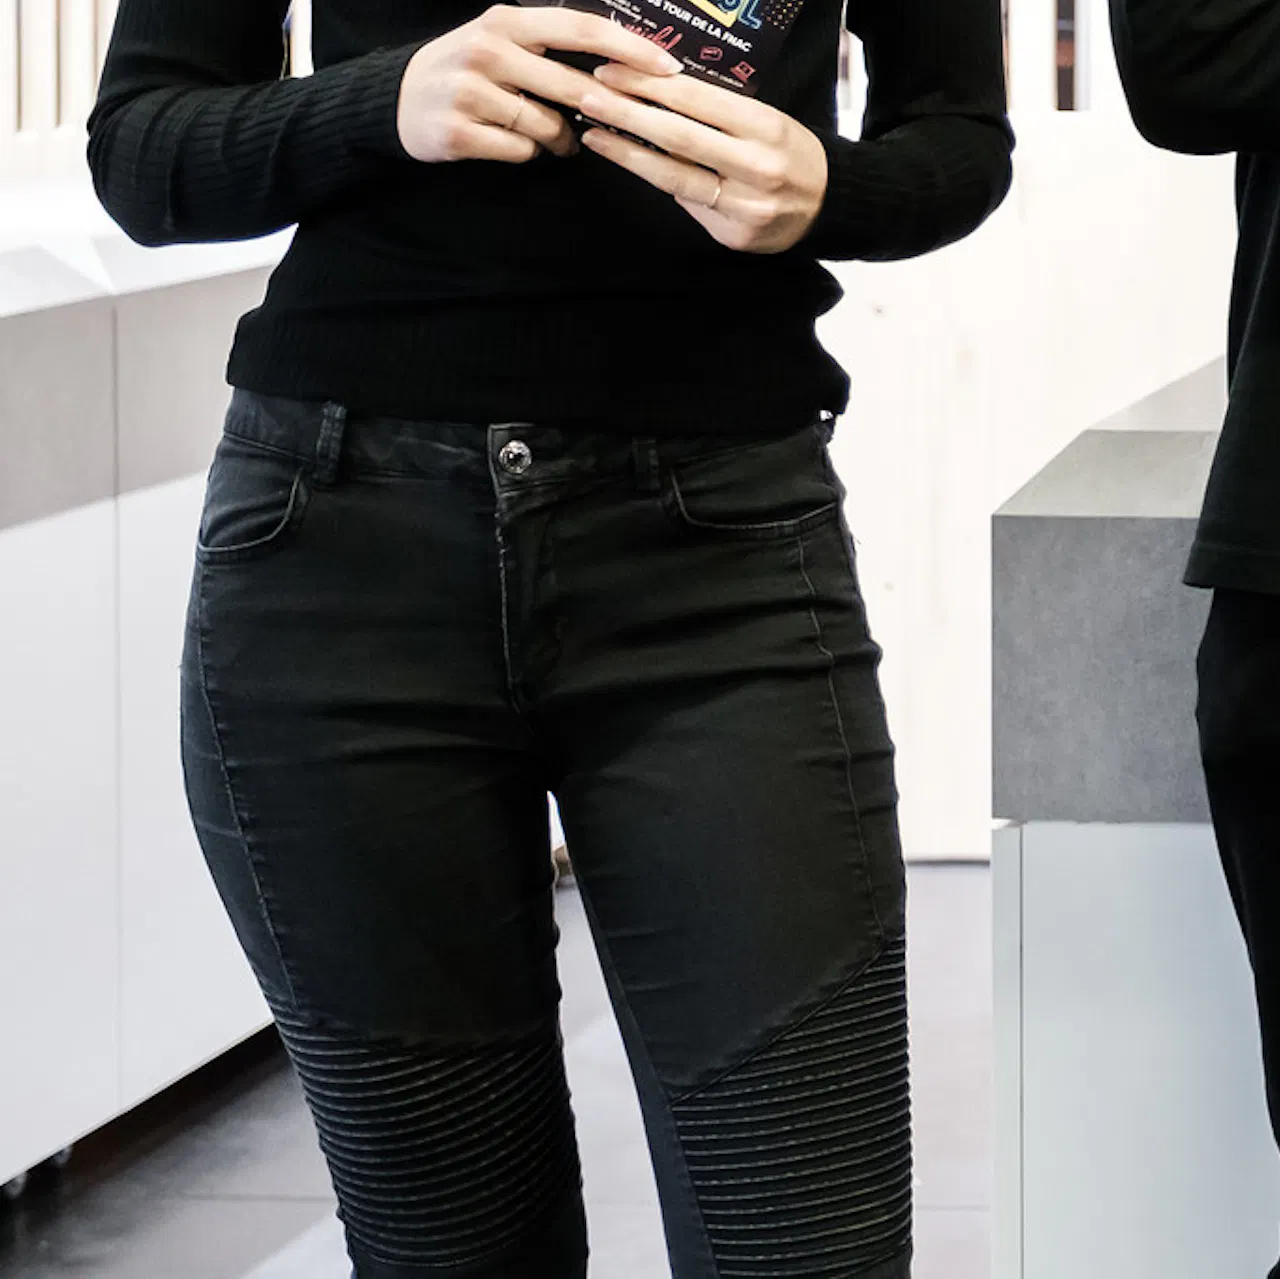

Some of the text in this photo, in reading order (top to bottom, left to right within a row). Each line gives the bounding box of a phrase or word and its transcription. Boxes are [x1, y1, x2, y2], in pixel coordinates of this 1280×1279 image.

[662, 0, 693, 24] TOUR
[691, 16, 707, 32] DE
[706, 24, 723, 40] LA
[721, 30, 753, 53] FNAC
